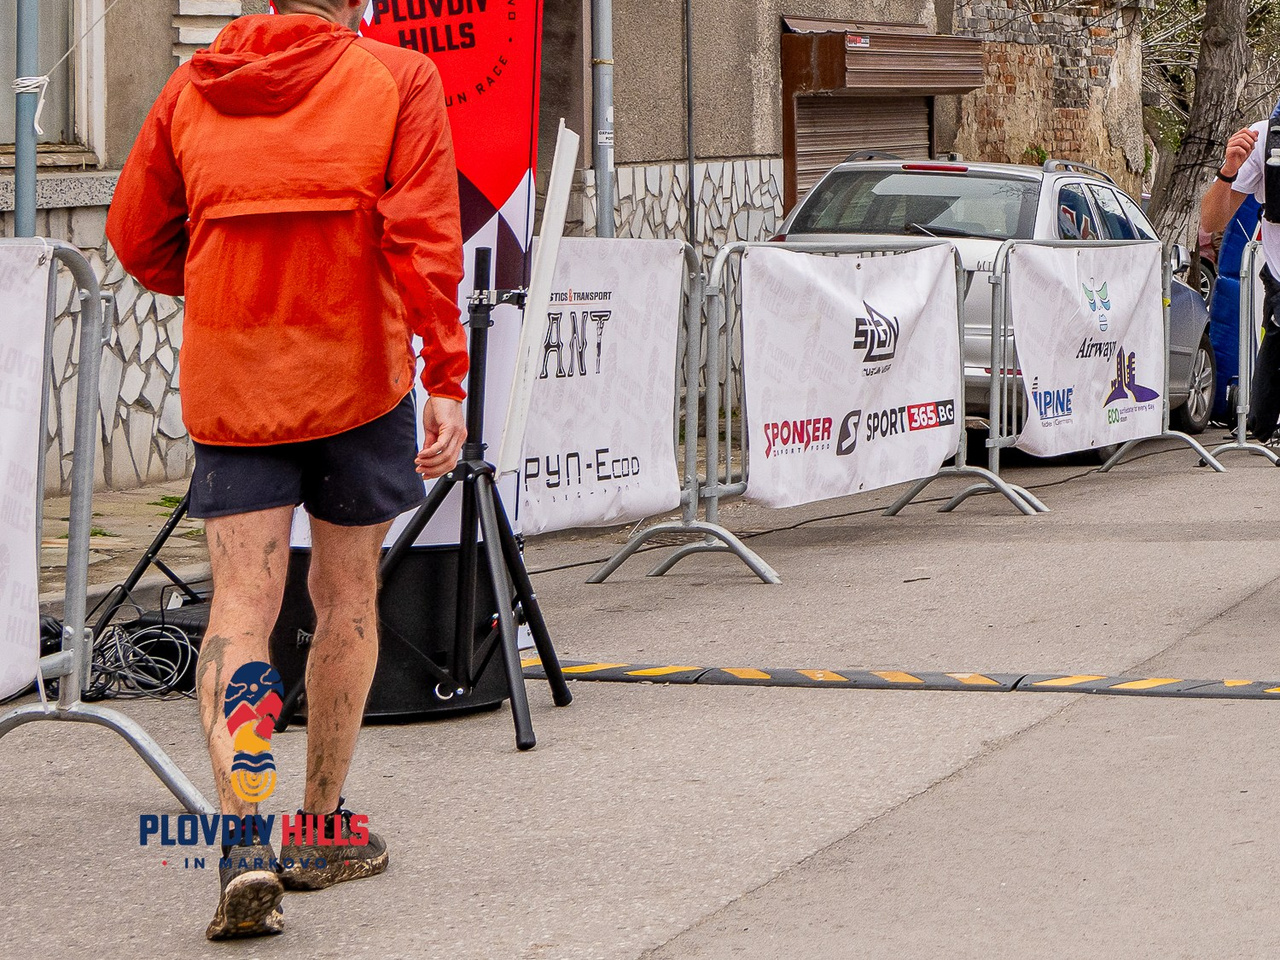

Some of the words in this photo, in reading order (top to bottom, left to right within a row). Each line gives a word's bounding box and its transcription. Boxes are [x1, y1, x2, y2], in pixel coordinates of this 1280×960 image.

[398, 22, 476, 54] HILLS
[445, 93, 467, 108] UN
[475, 55, 508, 94] RACE
[764, 417, 832, 458] SPONSER
